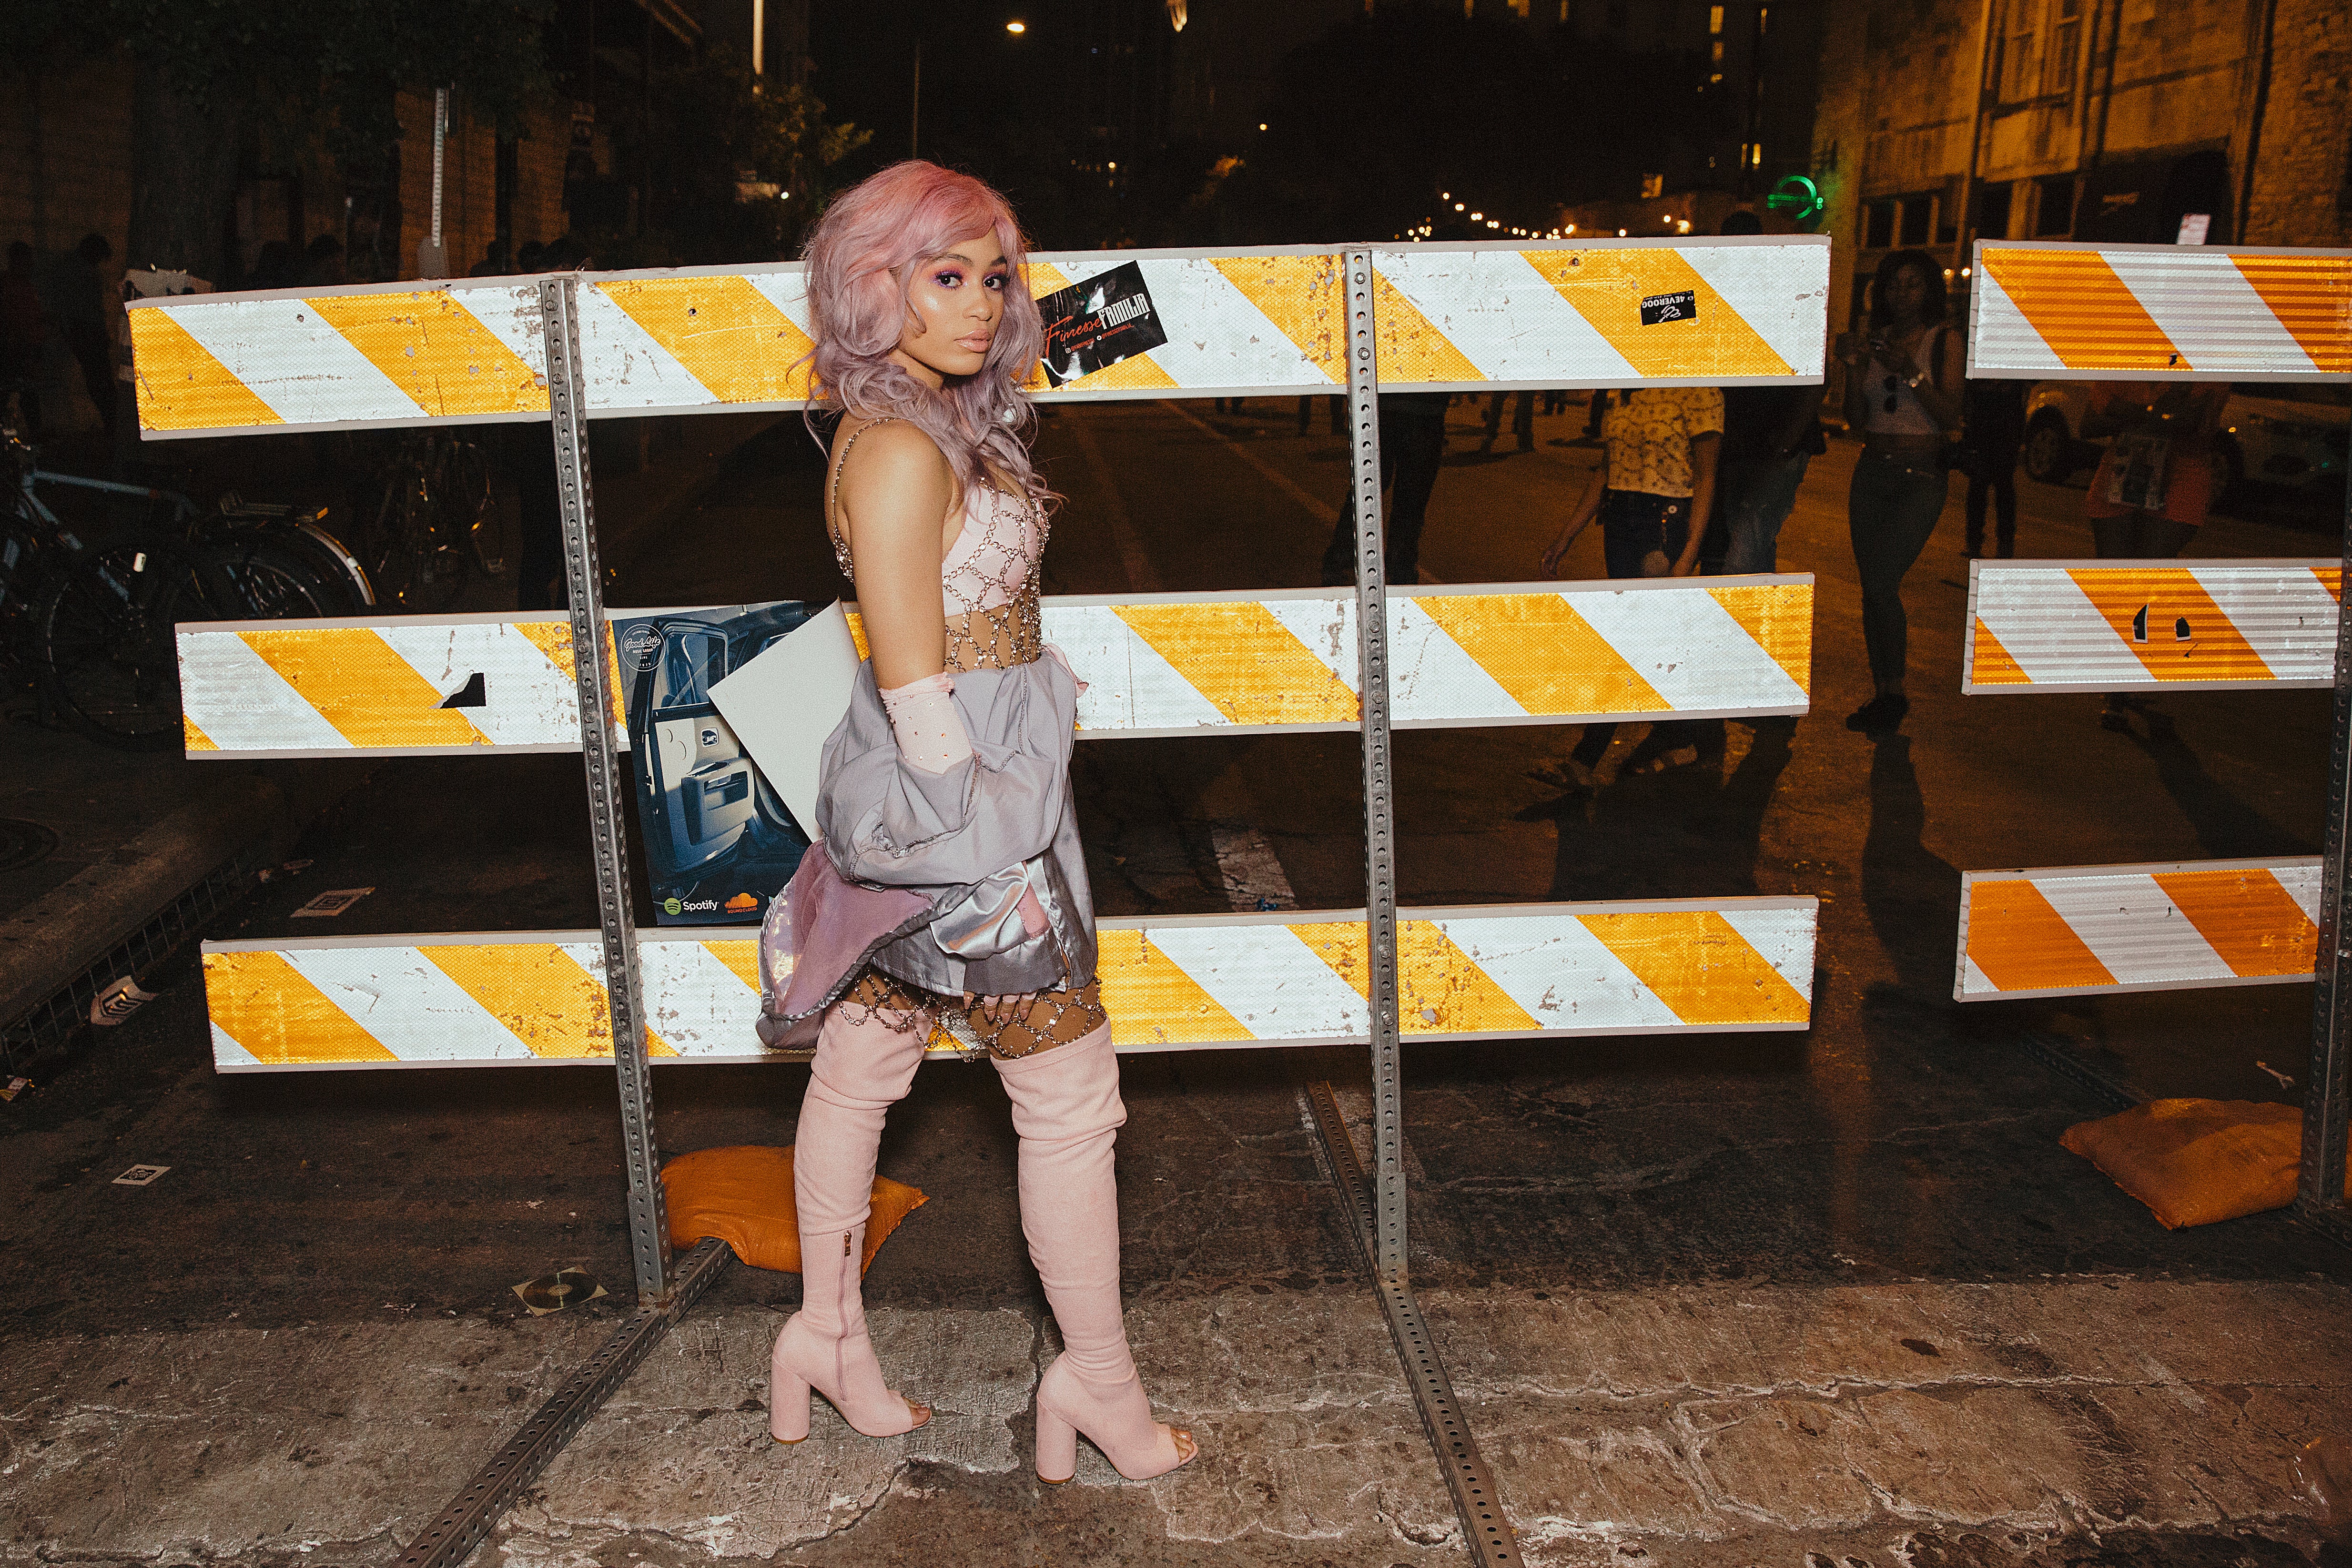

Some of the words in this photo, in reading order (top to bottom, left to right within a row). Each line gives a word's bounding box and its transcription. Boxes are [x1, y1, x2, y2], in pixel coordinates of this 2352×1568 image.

[1044, 315, 1102, 359] Finesse
[1097, 293, 1151, 330] FAMILIA
[624, 638, 644, 652] Good
[643, 636, 660, 648] Life
[683, 900, 718, 912] Spotify
